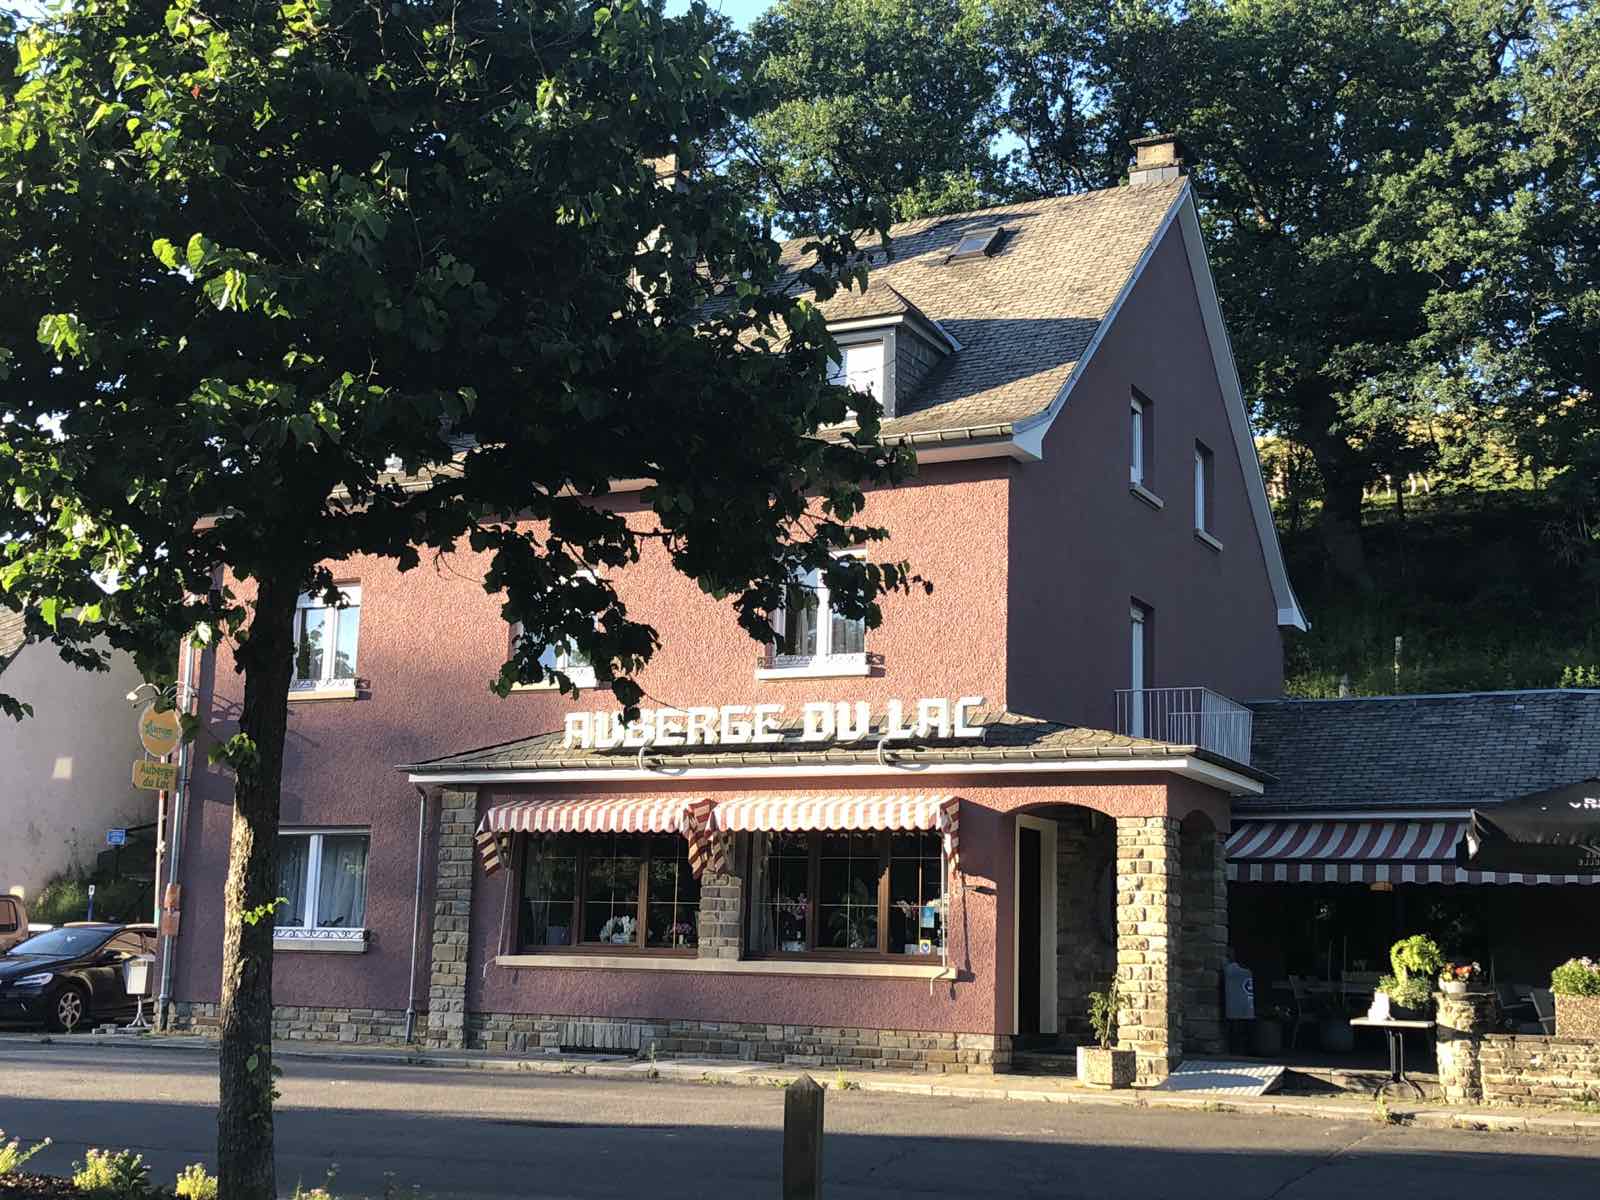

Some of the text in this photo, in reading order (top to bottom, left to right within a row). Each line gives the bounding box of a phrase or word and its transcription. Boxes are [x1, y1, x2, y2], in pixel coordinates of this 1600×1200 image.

[564, 696, 986, 749] AUBERGE DU LAC
